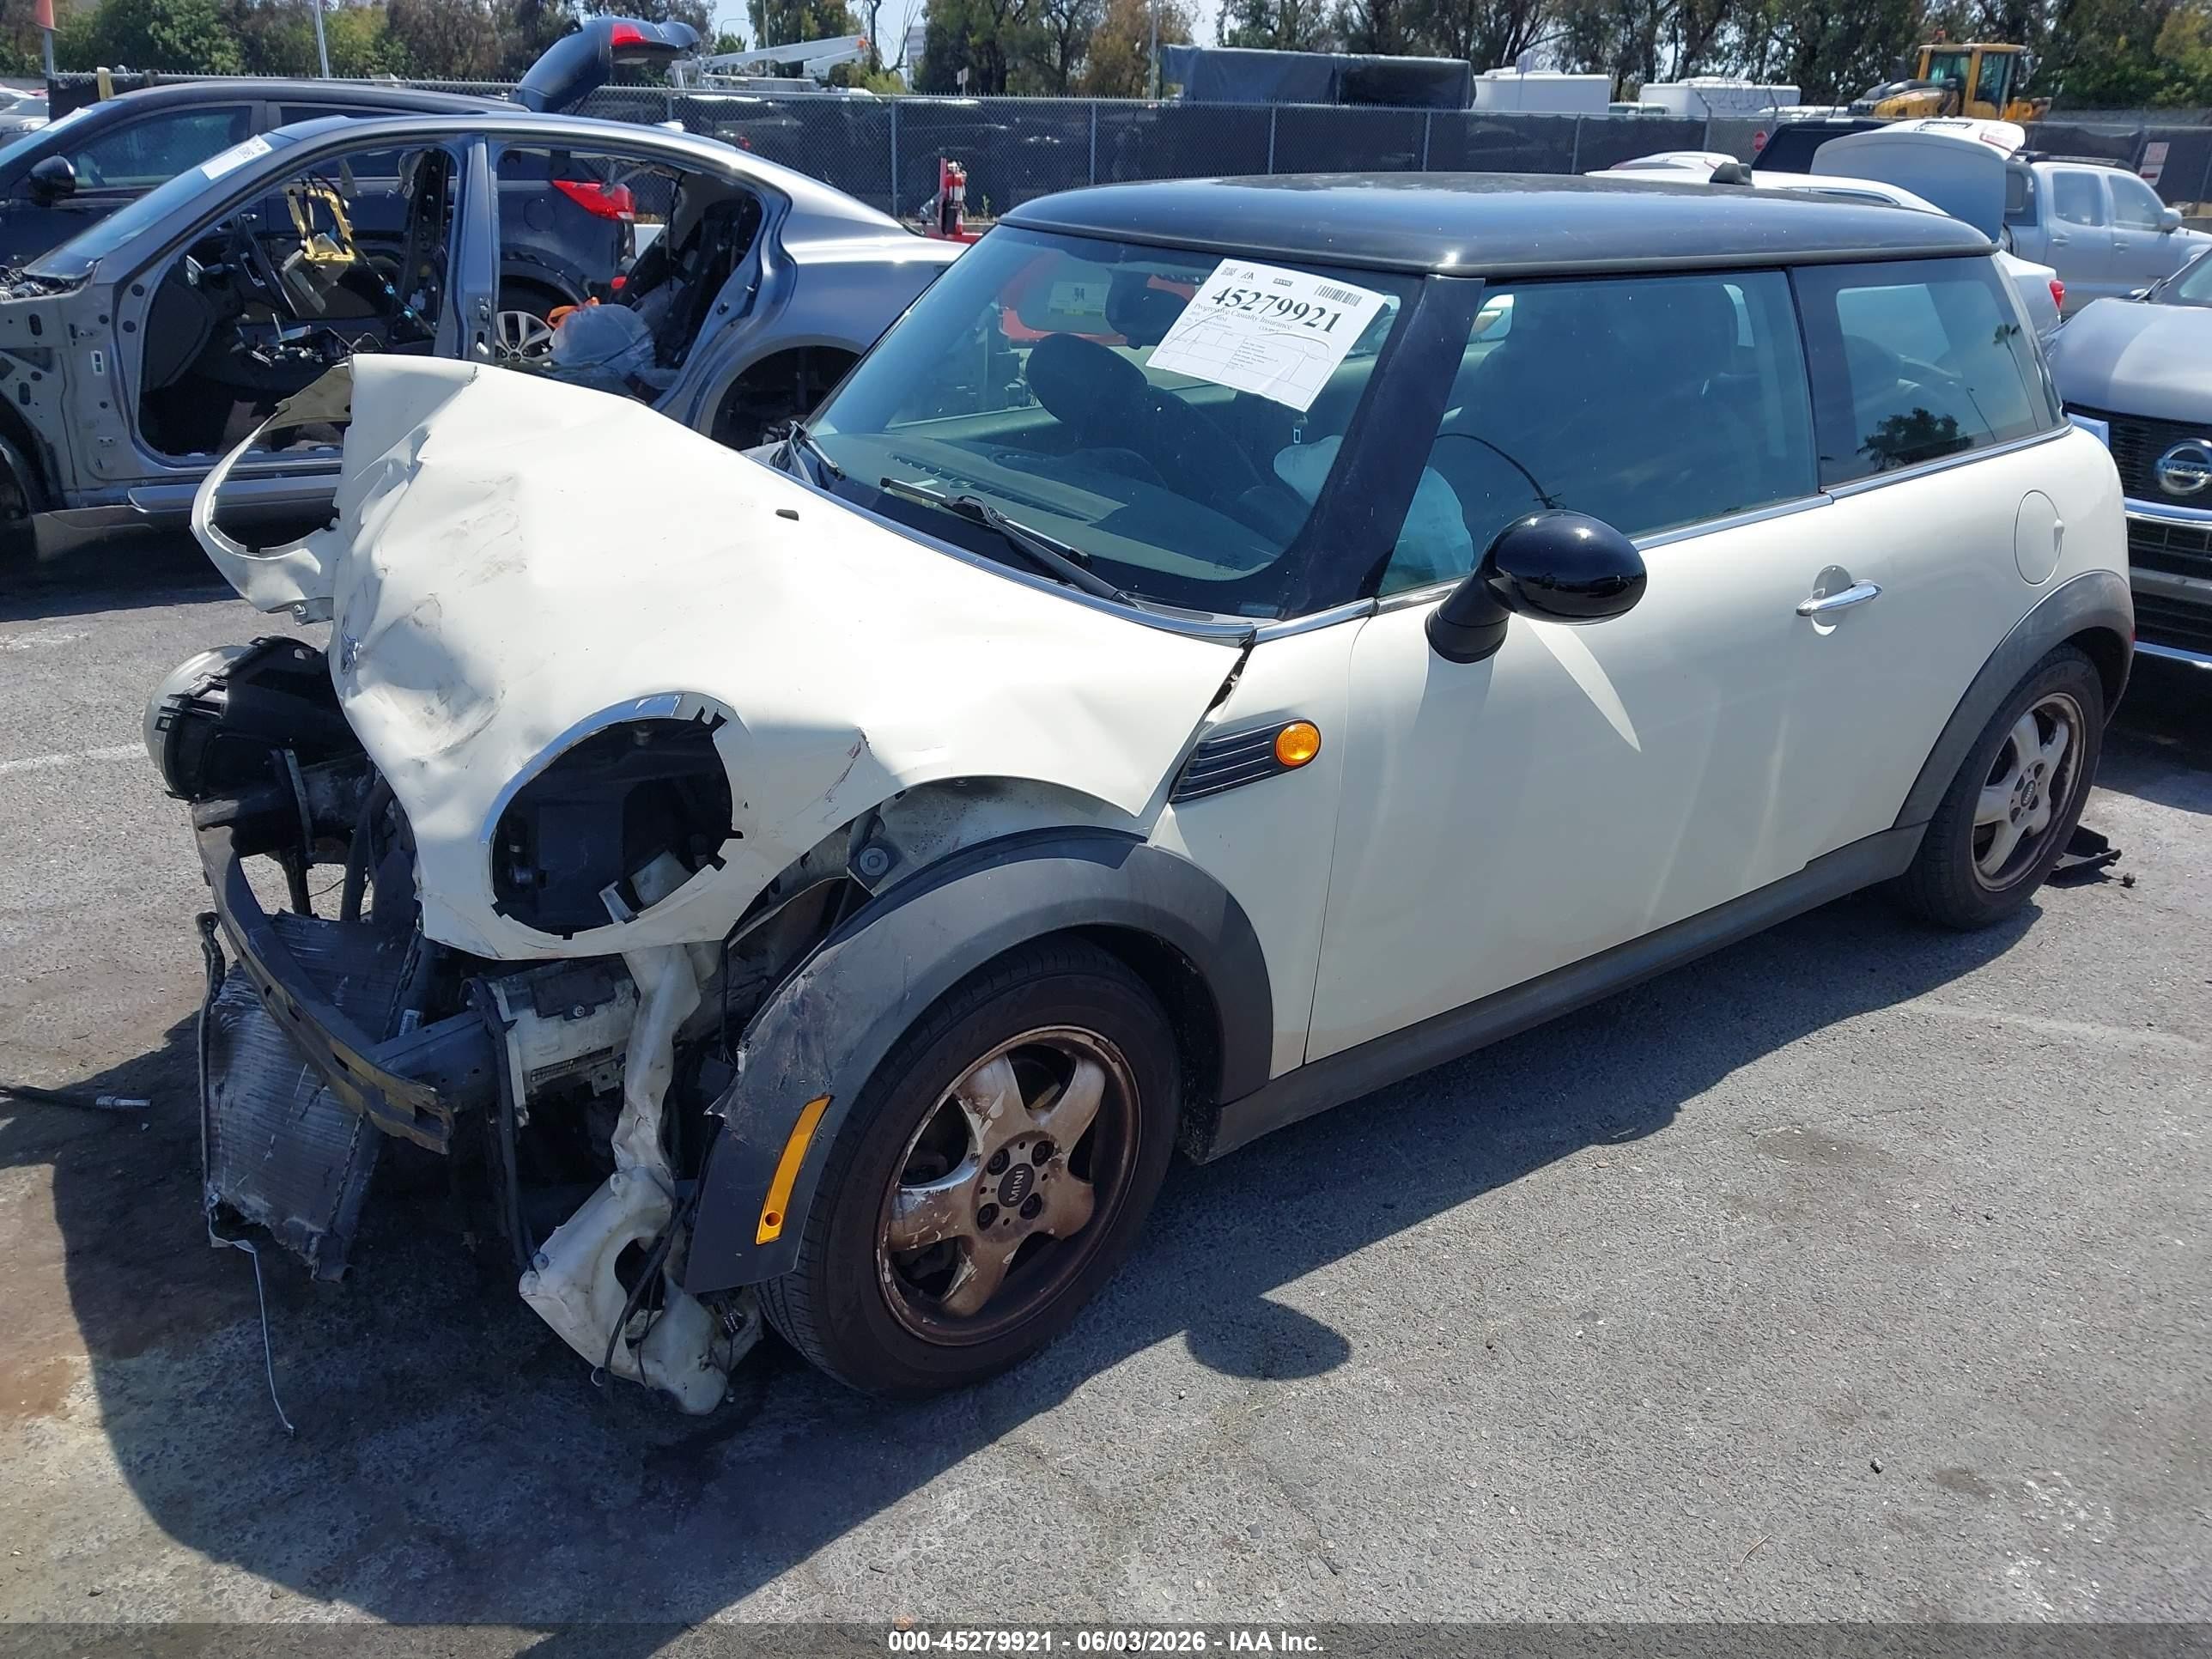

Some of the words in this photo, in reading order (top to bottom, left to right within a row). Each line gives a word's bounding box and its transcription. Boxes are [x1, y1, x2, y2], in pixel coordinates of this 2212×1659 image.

[1194, 302, 1230, 316] Progressive
[1231, 310, 1258, 321] Casualty
[1260, 316, 1292, 330] Insurance
[1212, 287, 1341, 333] 45279921
[1008, 1170, 1024, 1201] MINI
